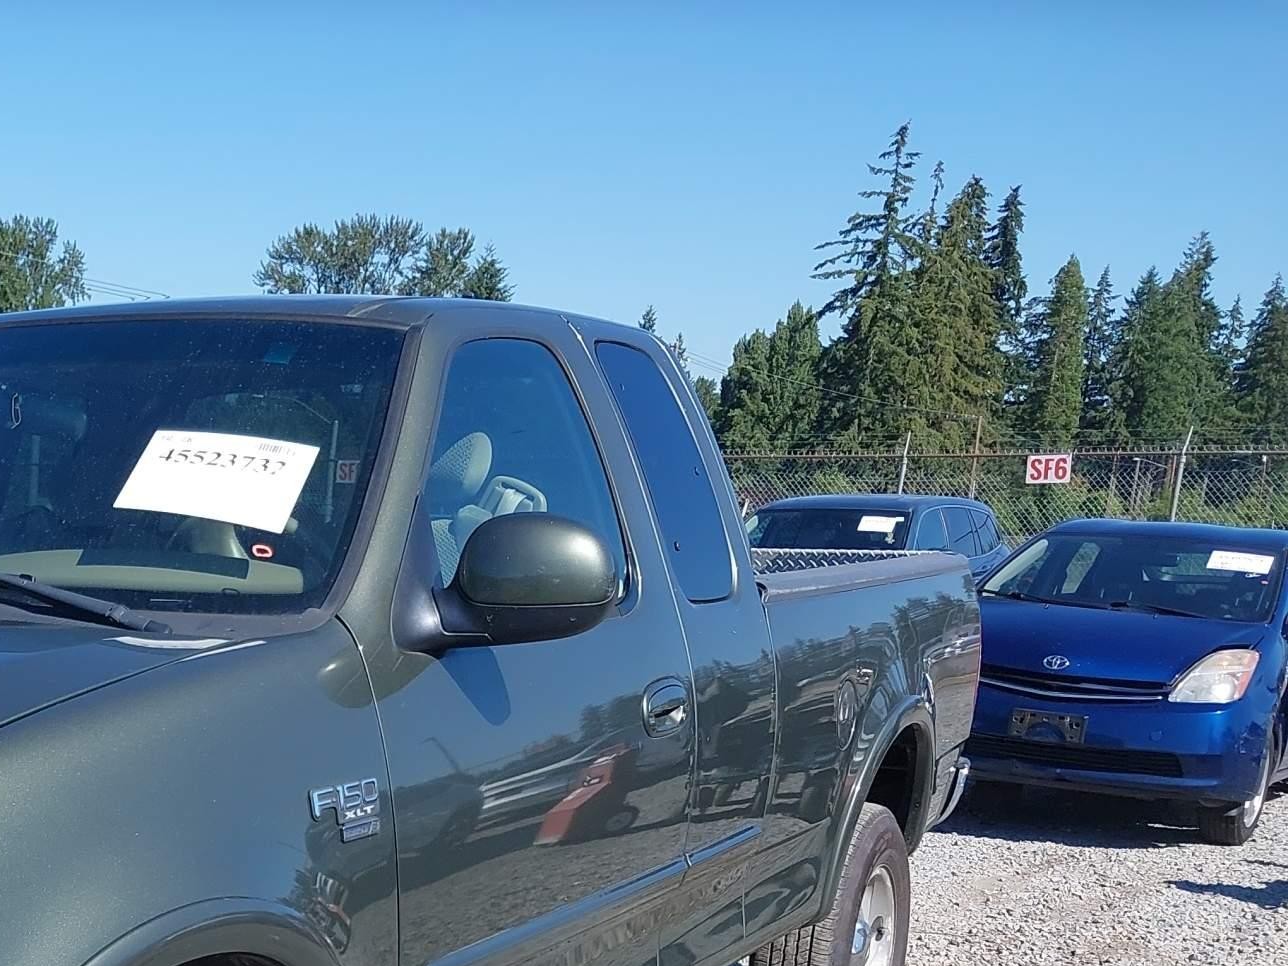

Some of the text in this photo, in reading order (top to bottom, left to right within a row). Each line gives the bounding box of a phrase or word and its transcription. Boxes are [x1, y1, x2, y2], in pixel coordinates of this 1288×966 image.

[338, 462, 359, 481] SF
[1030, 458, 1068, 481] SF6
[344, 805, 375, 820] XLT
